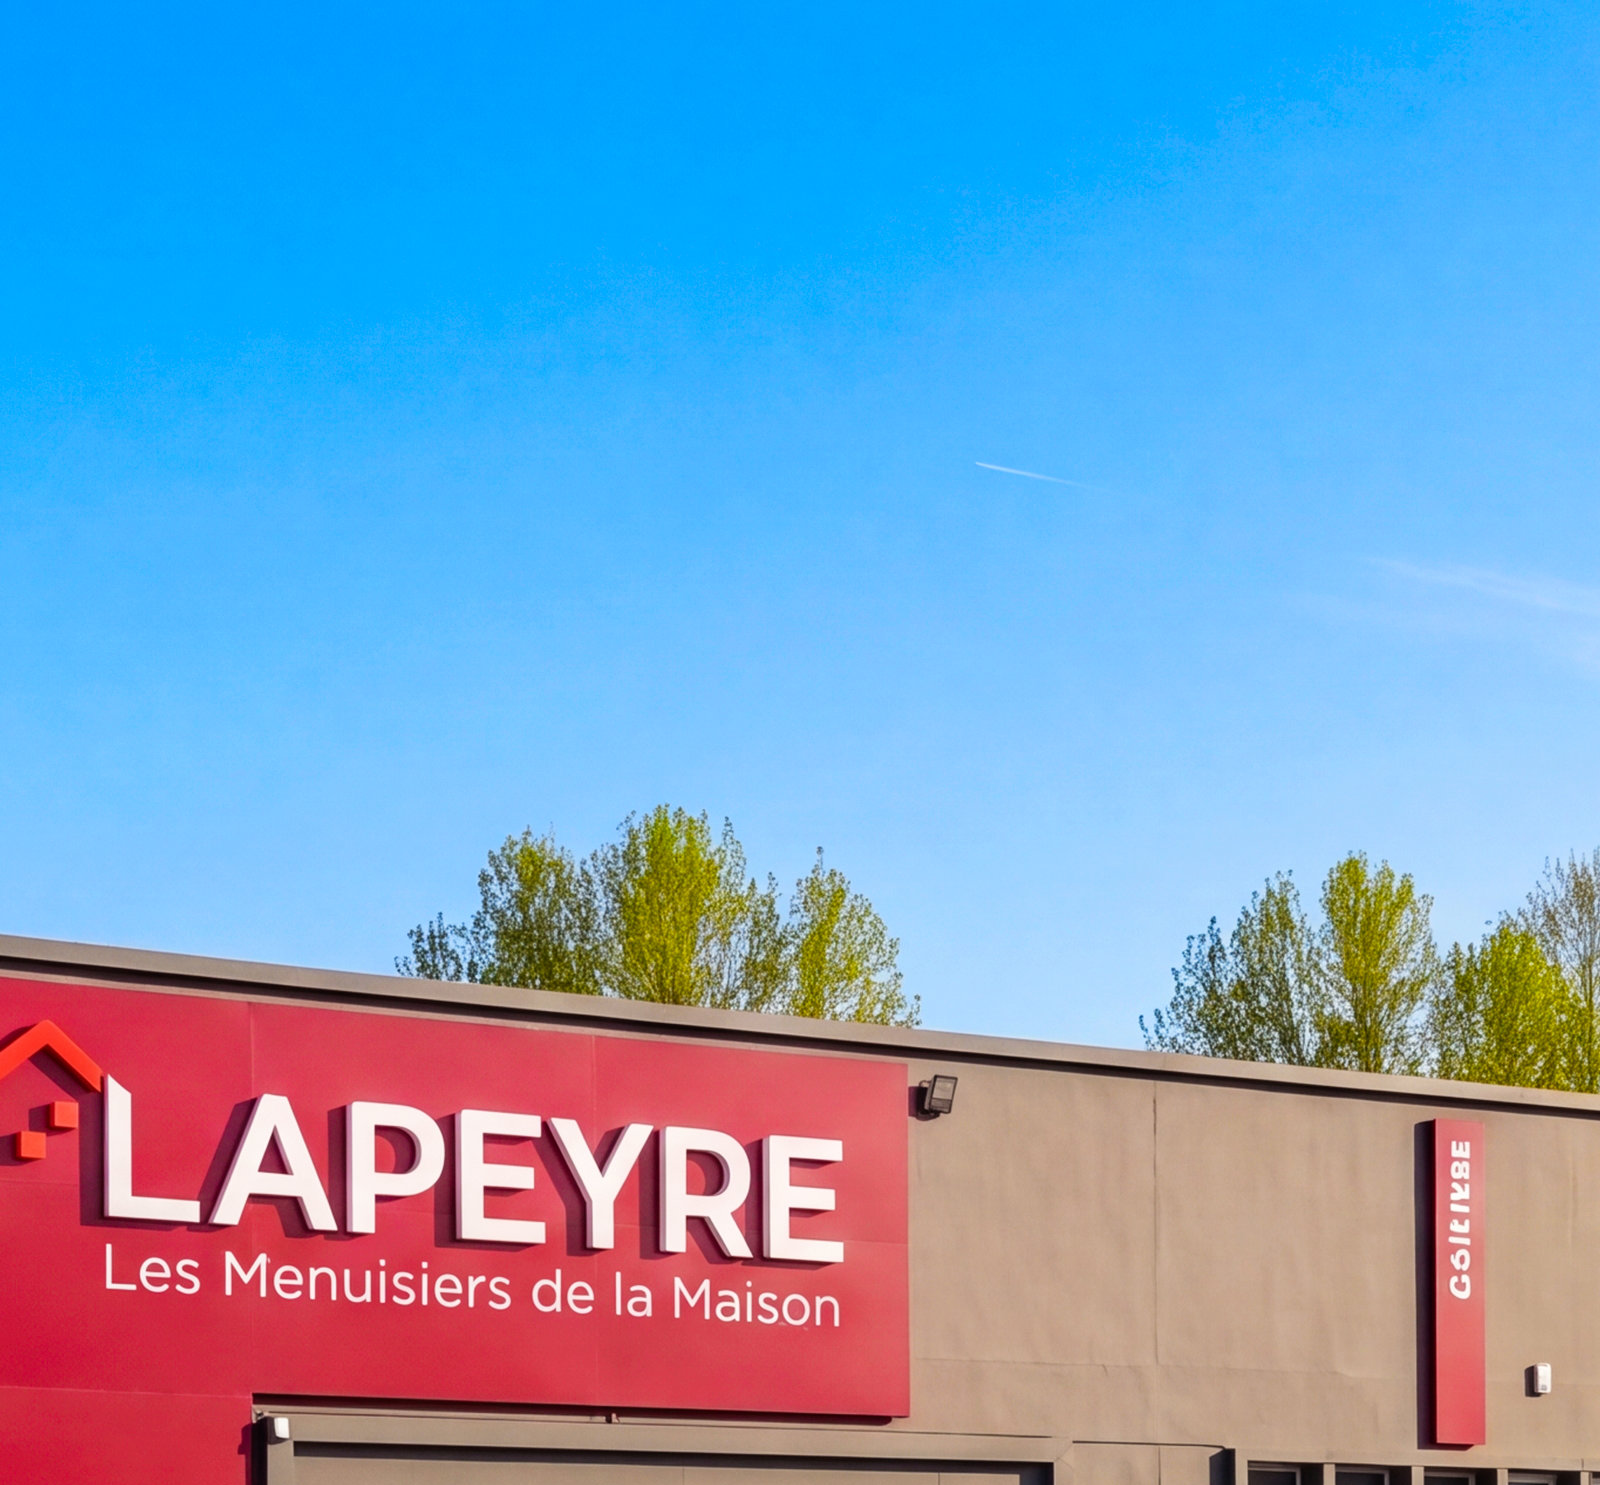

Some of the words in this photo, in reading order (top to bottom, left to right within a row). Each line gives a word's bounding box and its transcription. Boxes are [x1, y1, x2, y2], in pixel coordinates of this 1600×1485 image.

[104, 1073, 846, 1264] LAPEYRE
[104, 1242, 202, 1296] Les
[223, 1250, 513, 1311] Menuisiers
[531, 1268, 596, 1315] de
[613, 1271, 654, 1318] la
[673, 1276, 842, 1328] Maison
